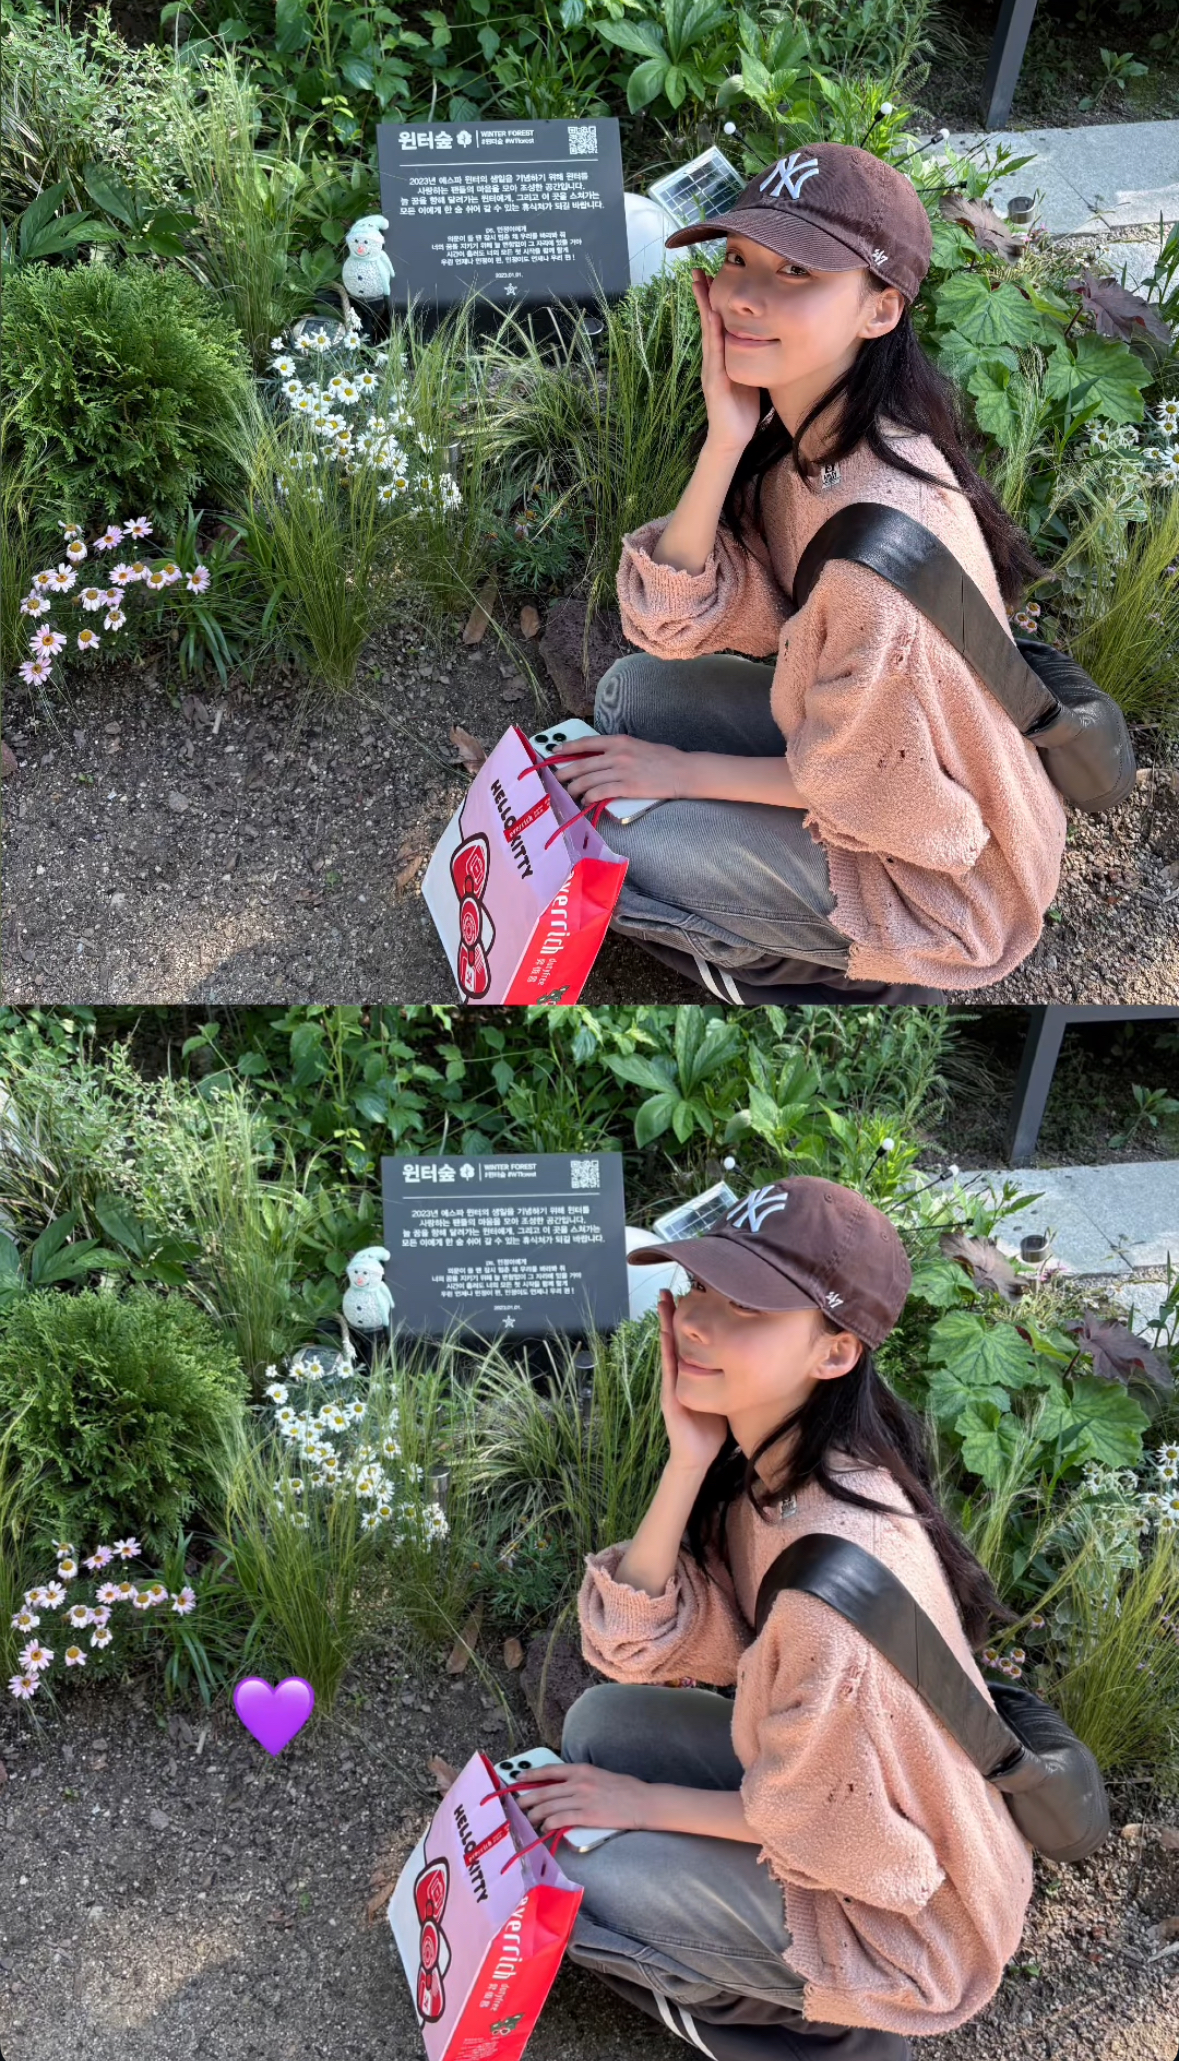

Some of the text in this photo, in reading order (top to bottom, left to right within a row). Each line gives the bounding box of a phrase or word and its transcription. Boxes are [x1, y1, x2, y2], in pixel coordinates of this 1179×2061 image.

[398, 131, 453, 150] 윈터숲
[760, 153, 819, 200] NY
[491, 779, 517, 831] HELLO
[402, 1164, 456, 1183] 윈터숲
[726, 1185, 788, 1232] NY
[454, 1804, 477, 1856] HELLO
[493, 1896, 528, 1980] everrich
